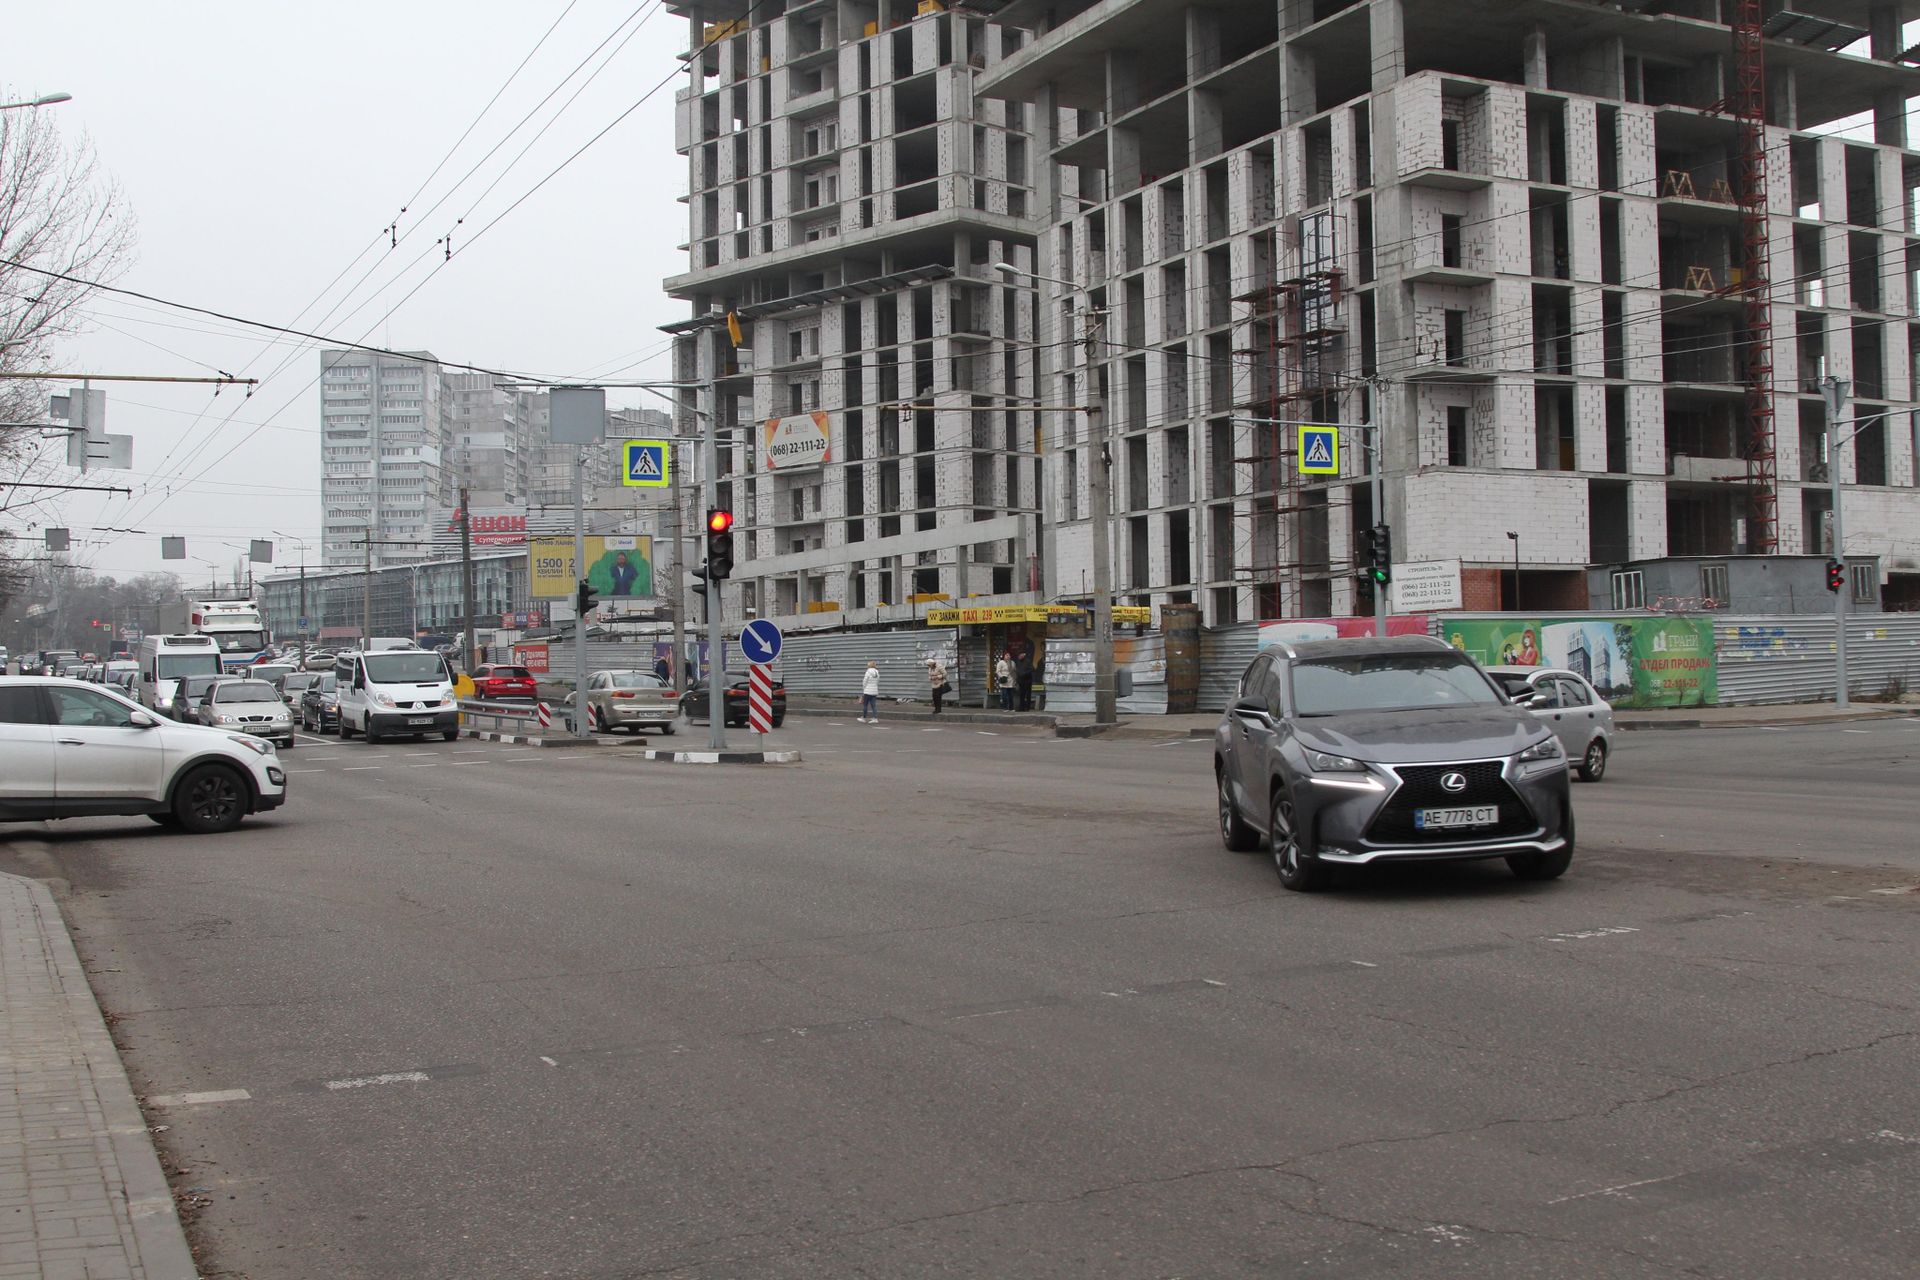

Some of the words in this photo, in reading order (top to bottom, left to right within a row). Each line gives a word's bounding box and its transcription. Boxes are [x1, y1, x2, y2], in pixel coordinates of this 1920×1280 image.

[770, 443, 788, 457] (068)
[789, 438, 825, 454] 22-111-22
[536, 558, 563, 568] 1500
[1401, 583, 1418, 591] (066)
[1419, 581, 1451, 589] 22-111-22
[1420, 588, 1452, 597] 22-111-22
[963, 610, 978, 622] TAXI
[982, 609, 993, 621] 239
[1639, 658, 1669, 672] ОТДЕЛ
[1671, 656, 1711, 671] ПРОДАЖ
[1425, 812, 1442, 824] AE
[1445, 810, 1473, 823] 7778
[1476, 808, 1494, 821] CT
